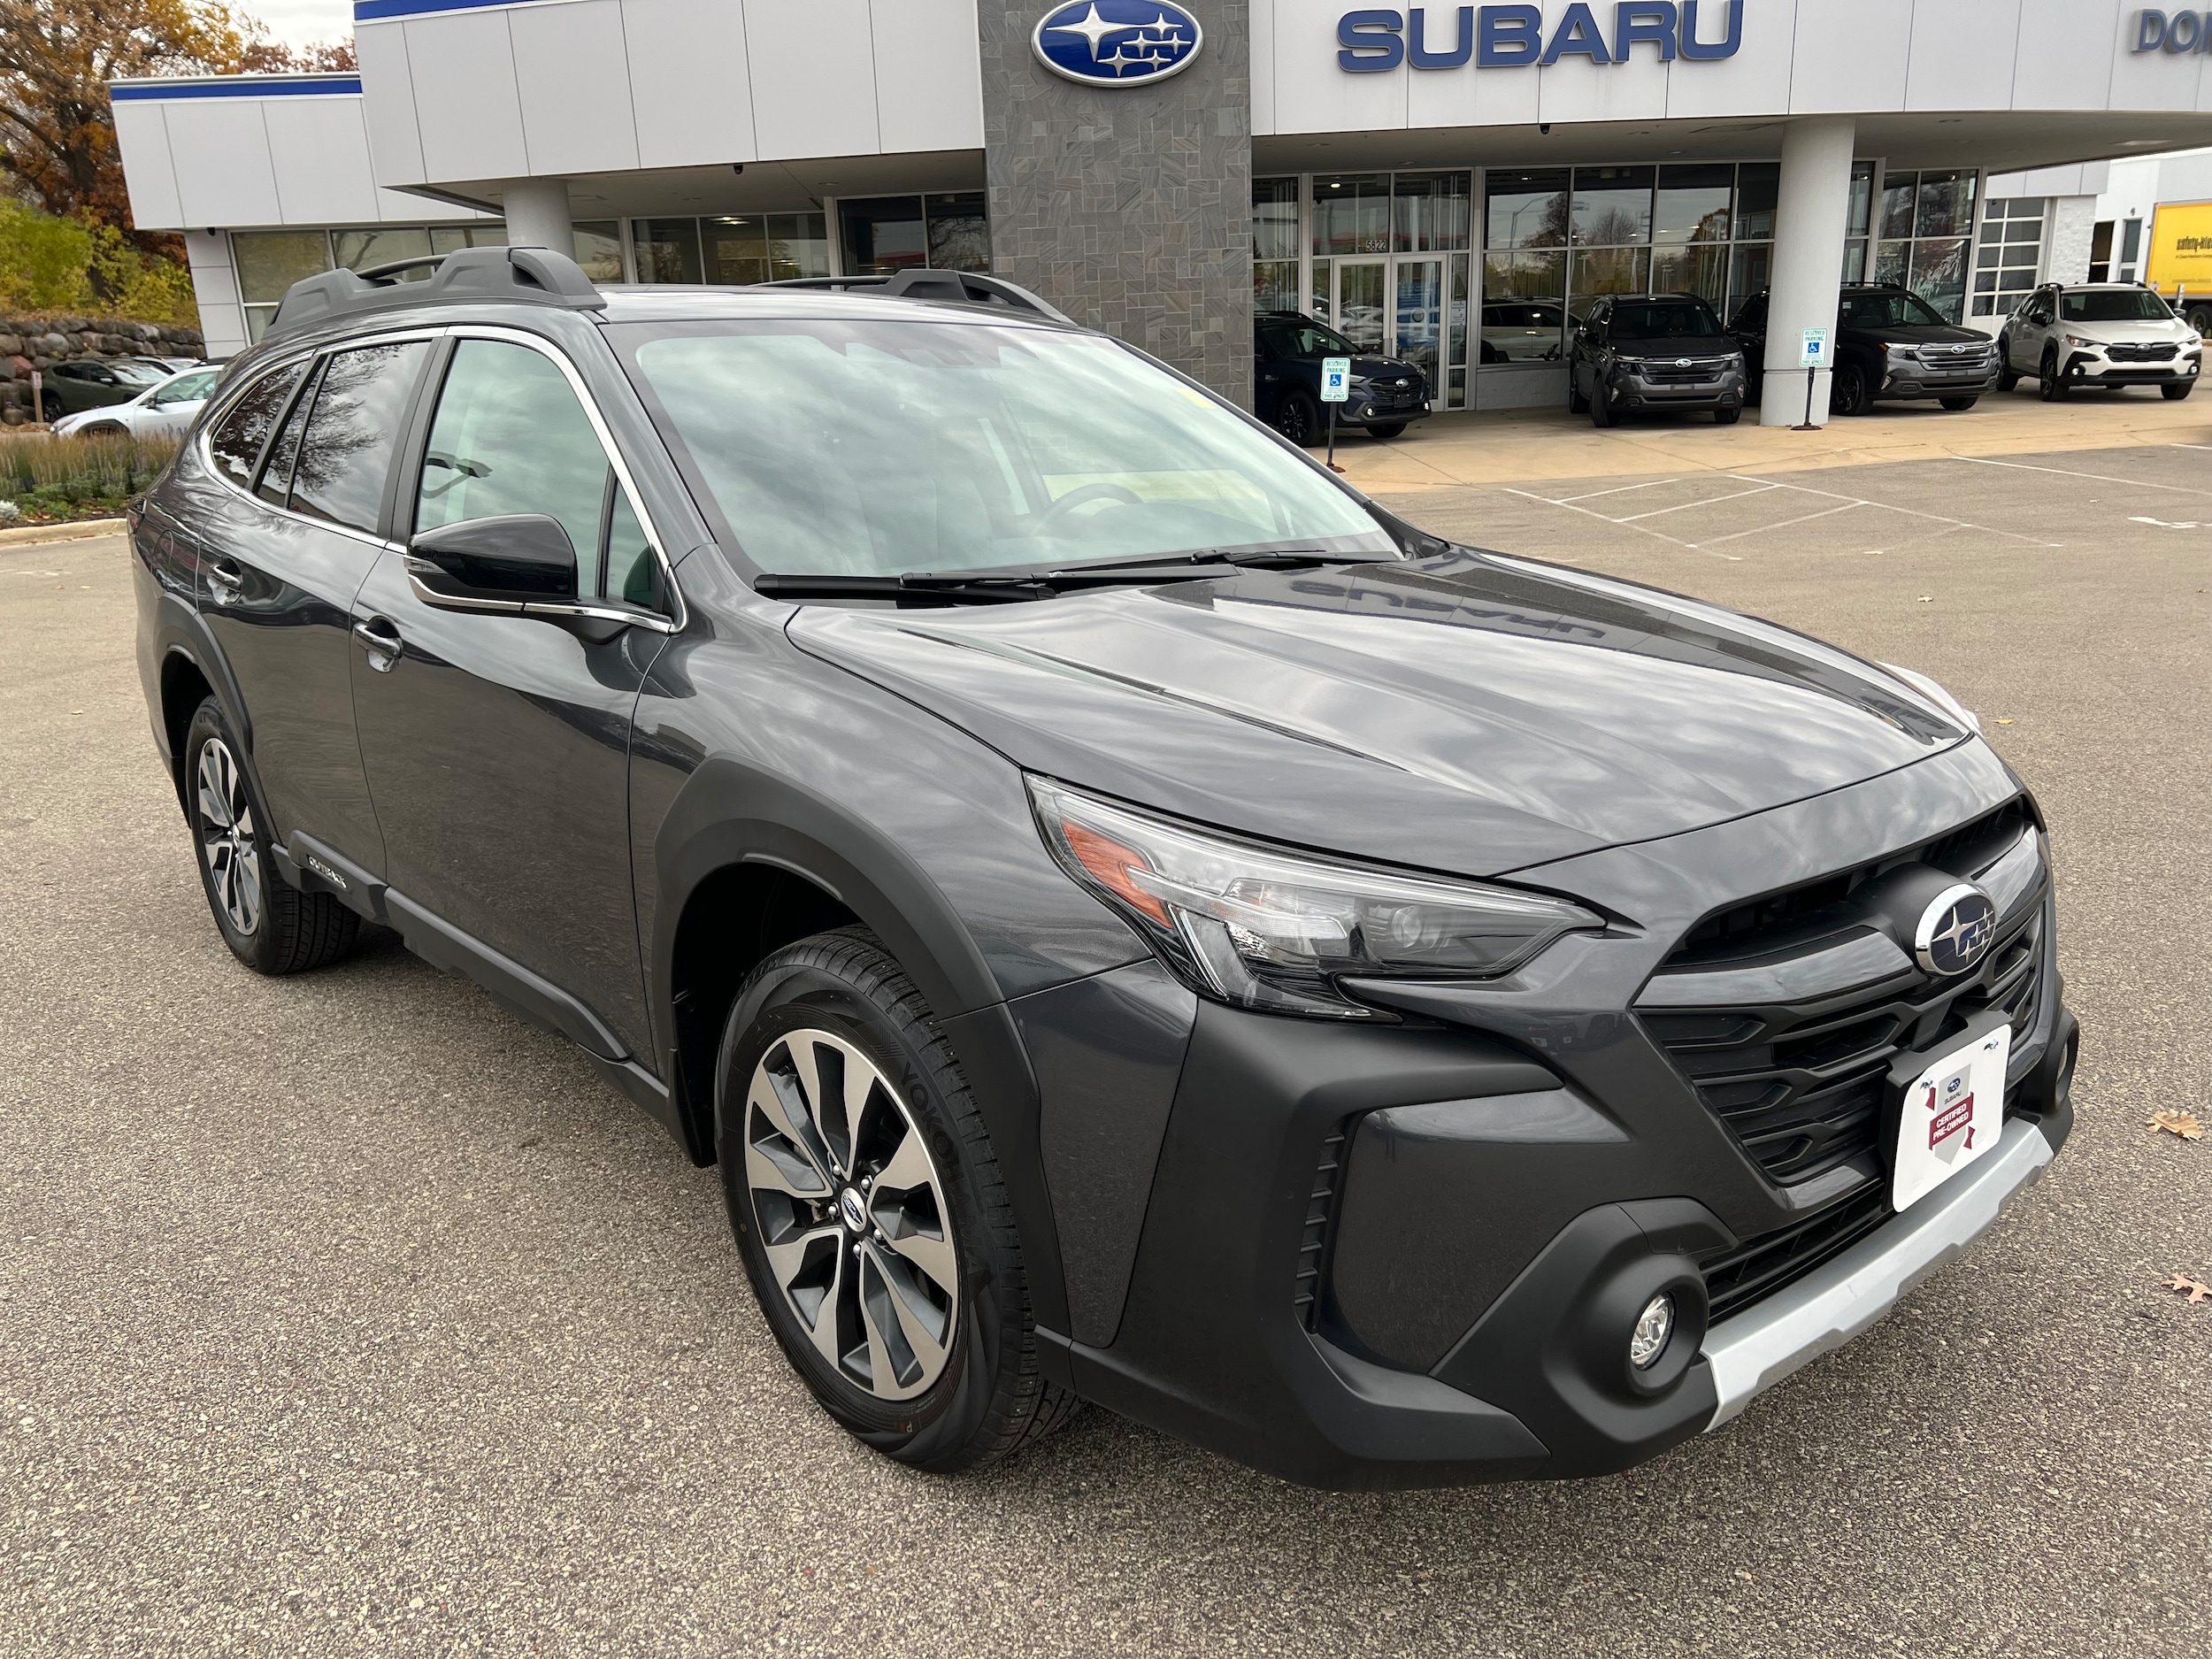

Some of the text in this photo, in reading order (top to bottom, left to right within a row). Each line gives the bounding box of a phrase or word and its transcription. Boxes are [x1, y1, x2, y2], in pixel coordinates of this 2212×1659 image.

[1338, 0, 1742, 73] SUBARU
[1366, 240, 1386, 251] 5822
[1944, 1090, 1962, 1105] SUBARU
[1932, 1110, 1970, 1141] PRE-OWNED
[1936, 1102, 1967, 1128] CERTIFIED
